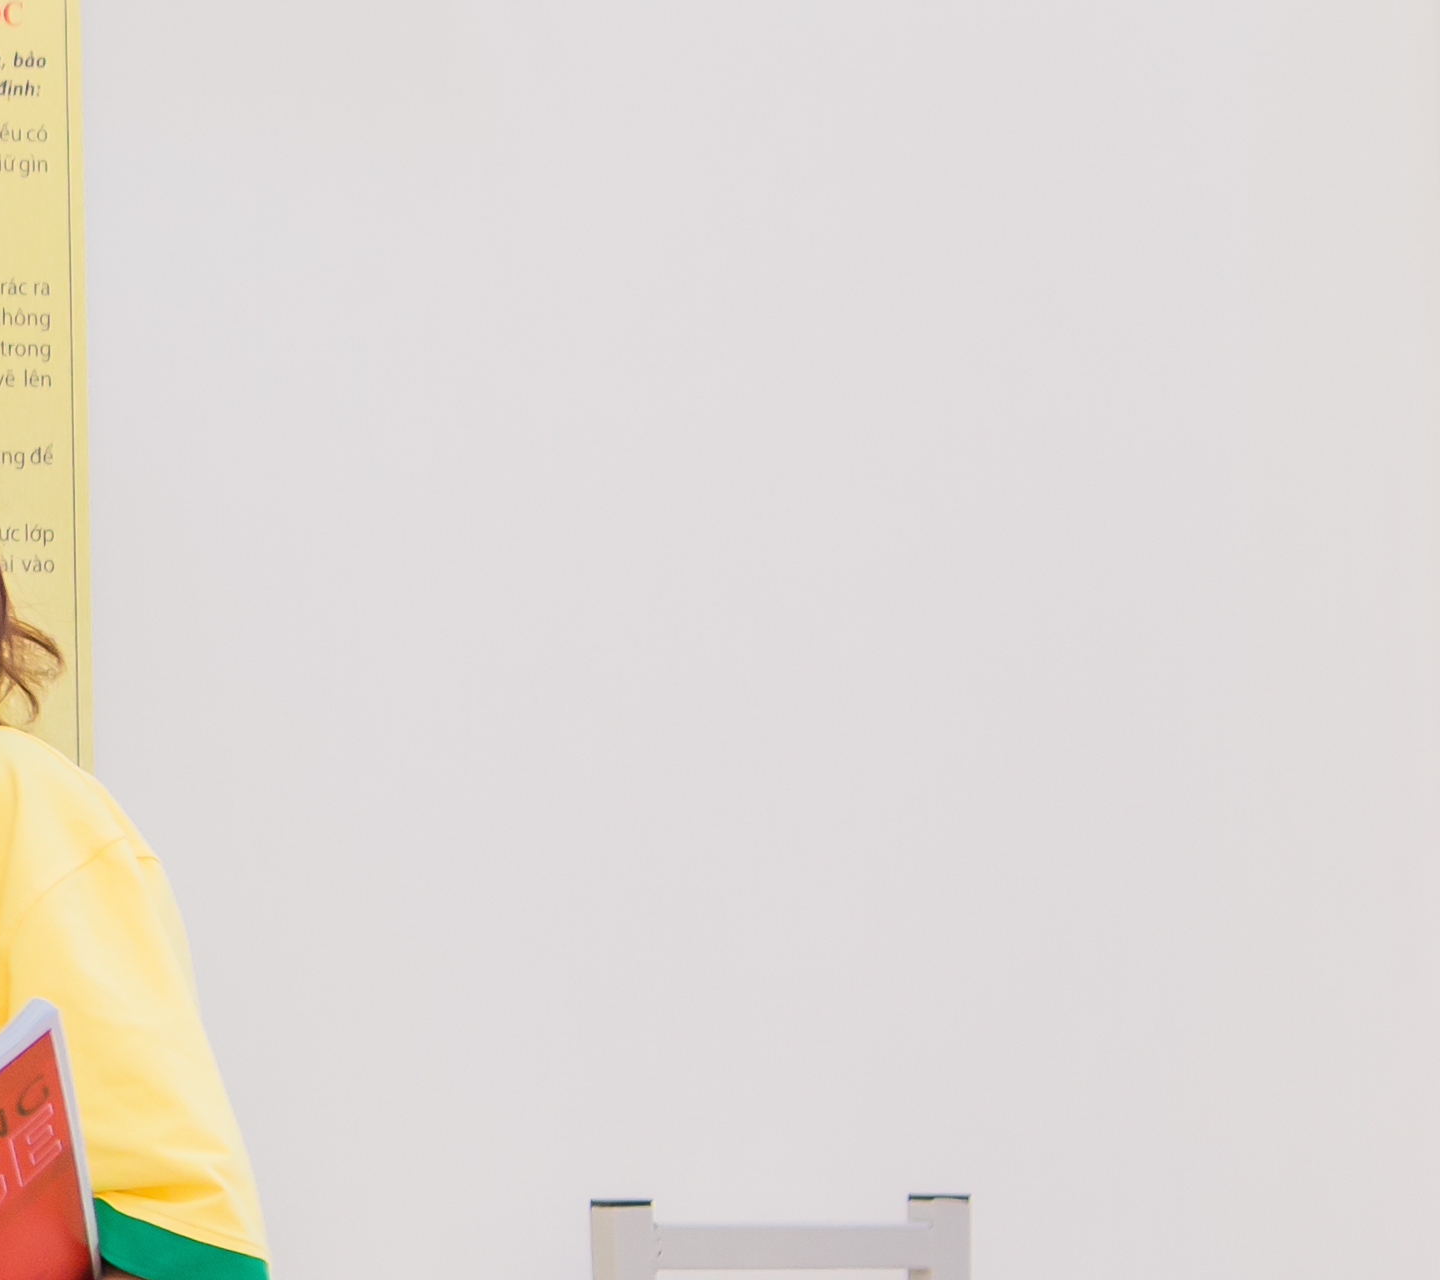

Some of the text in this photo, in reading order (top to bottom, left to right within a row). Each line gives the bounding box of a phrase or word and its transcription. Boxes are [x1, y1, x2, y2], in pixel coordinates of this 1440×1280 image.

[13, 51, 47, 69] bảo
[26, 123, 48, 143] có
[19, 153, 48, 177] gìn
[0, 276, 28, 296] rác
[33, 281, 50, 296] ra
[1, 341, 51, 361] trong
[23, 367, 52, 389] lên
[30, 443, 54, 465] để
[25, 523, 55, 548] lớp
[22, 554, 55, 573] vào
